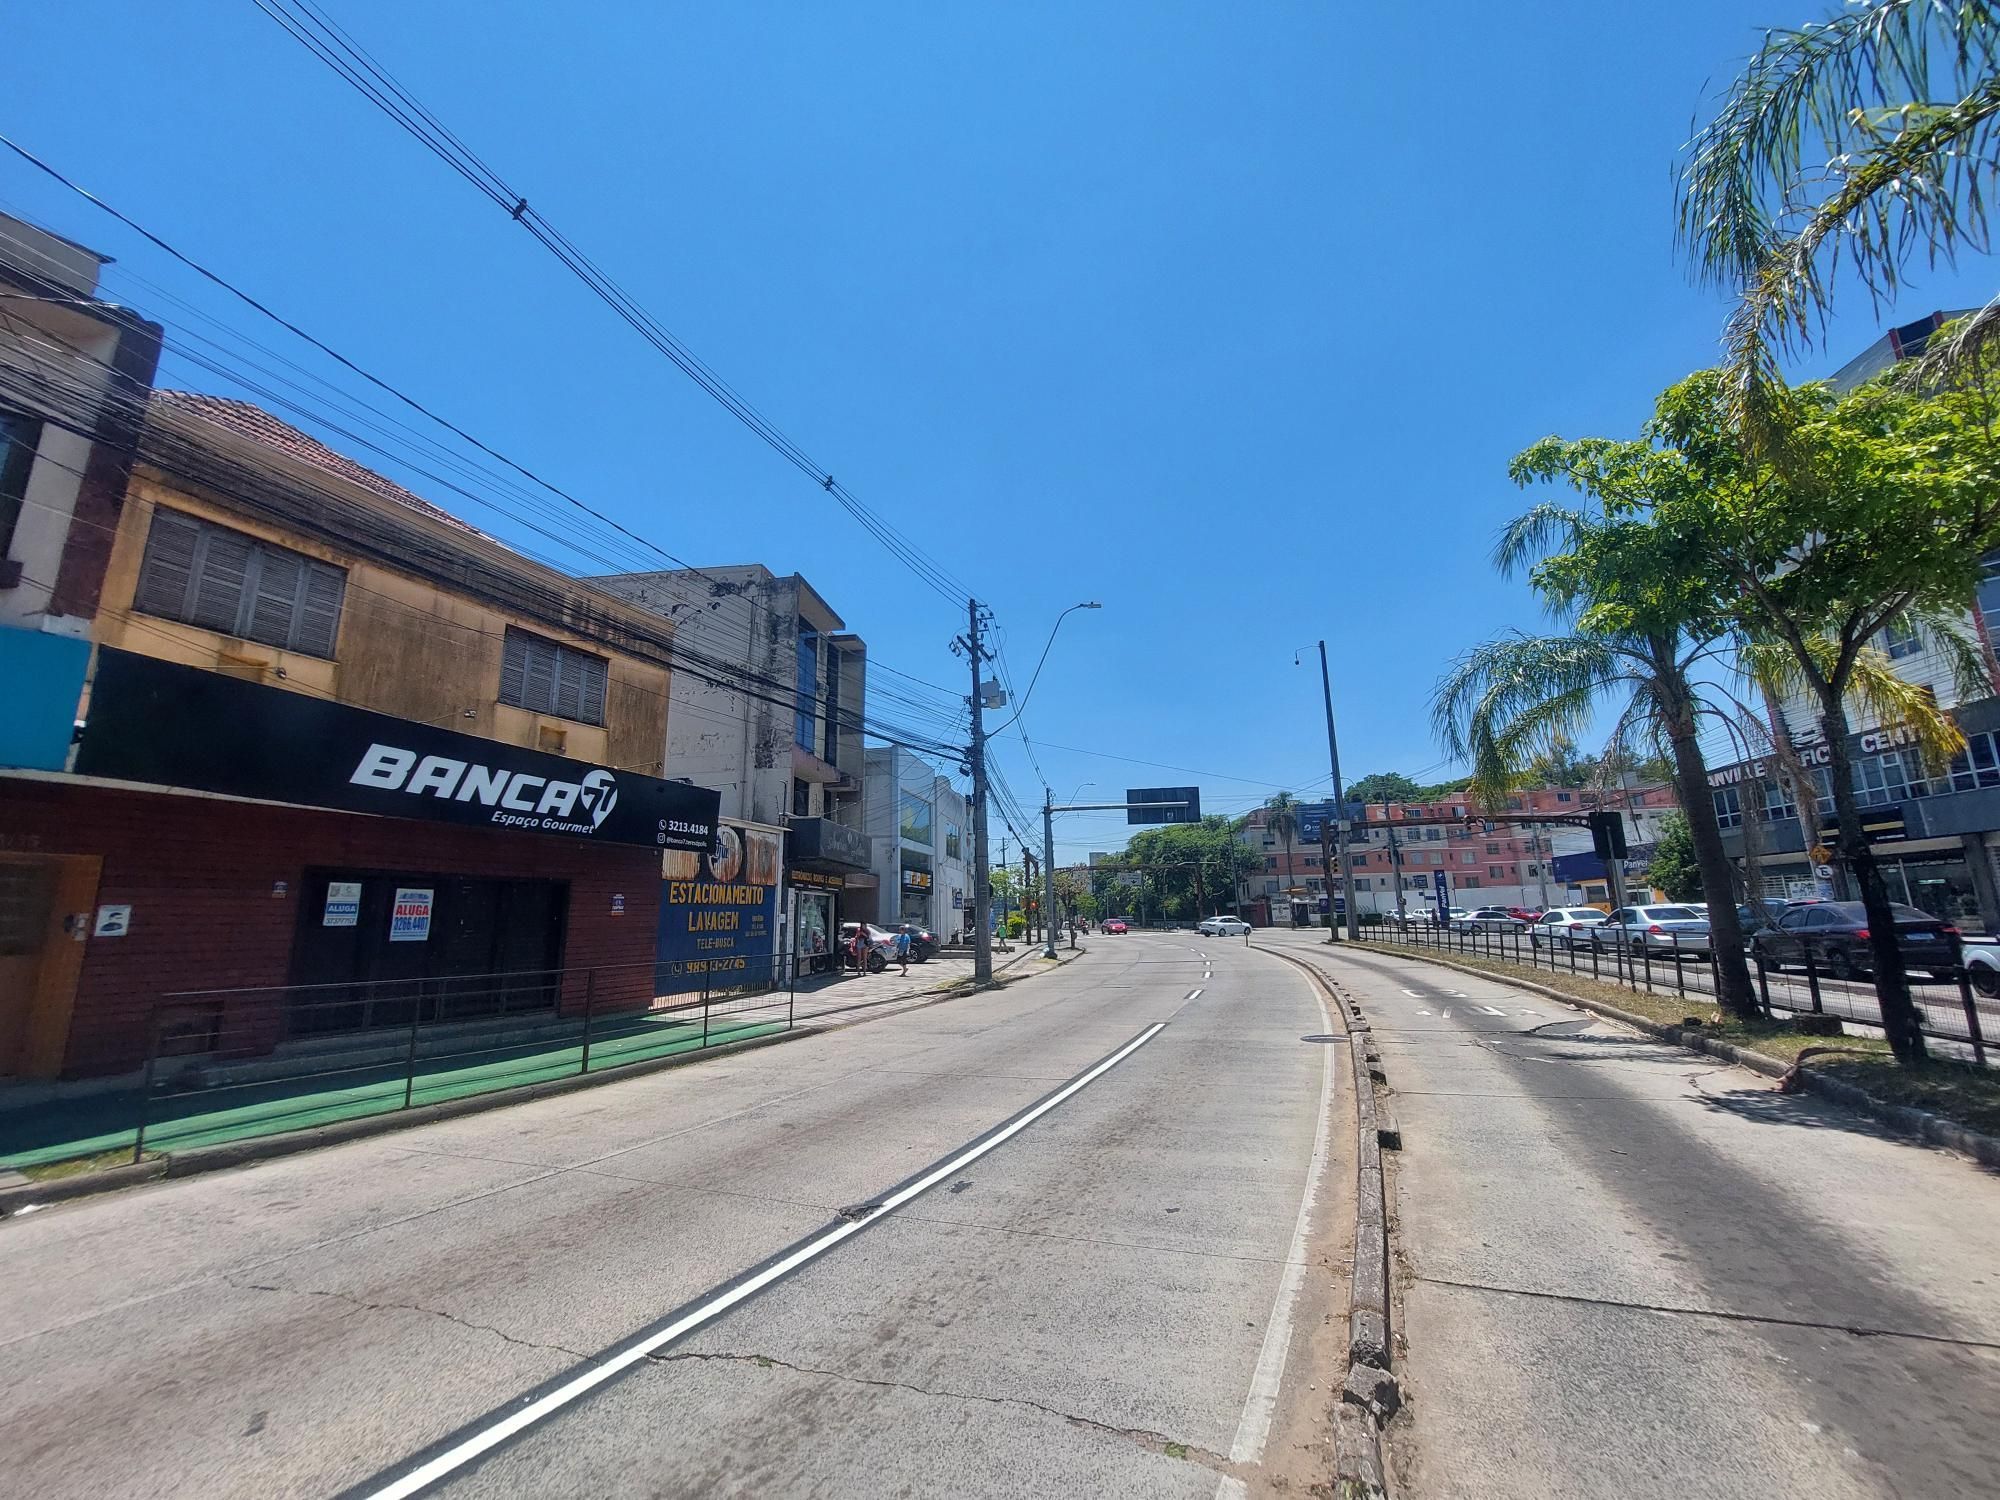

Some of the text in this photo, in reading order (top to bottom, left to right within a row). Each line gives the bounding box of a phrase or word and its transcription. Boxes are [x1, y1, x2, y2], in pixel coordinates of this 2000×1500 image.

[349, 743, 582, 817] BANCA
[491, 811, 595, 834] Espaço Gourmet
[668, 820, 708, 836] 3213.4184
[669, 881, 764, 905] ESTACIONAMENTO
[328, 904, 357, 913] ALUGA
[395, 904, 430, 916] ALUGA
[688, 911, 739, 932] LAVAGEM
